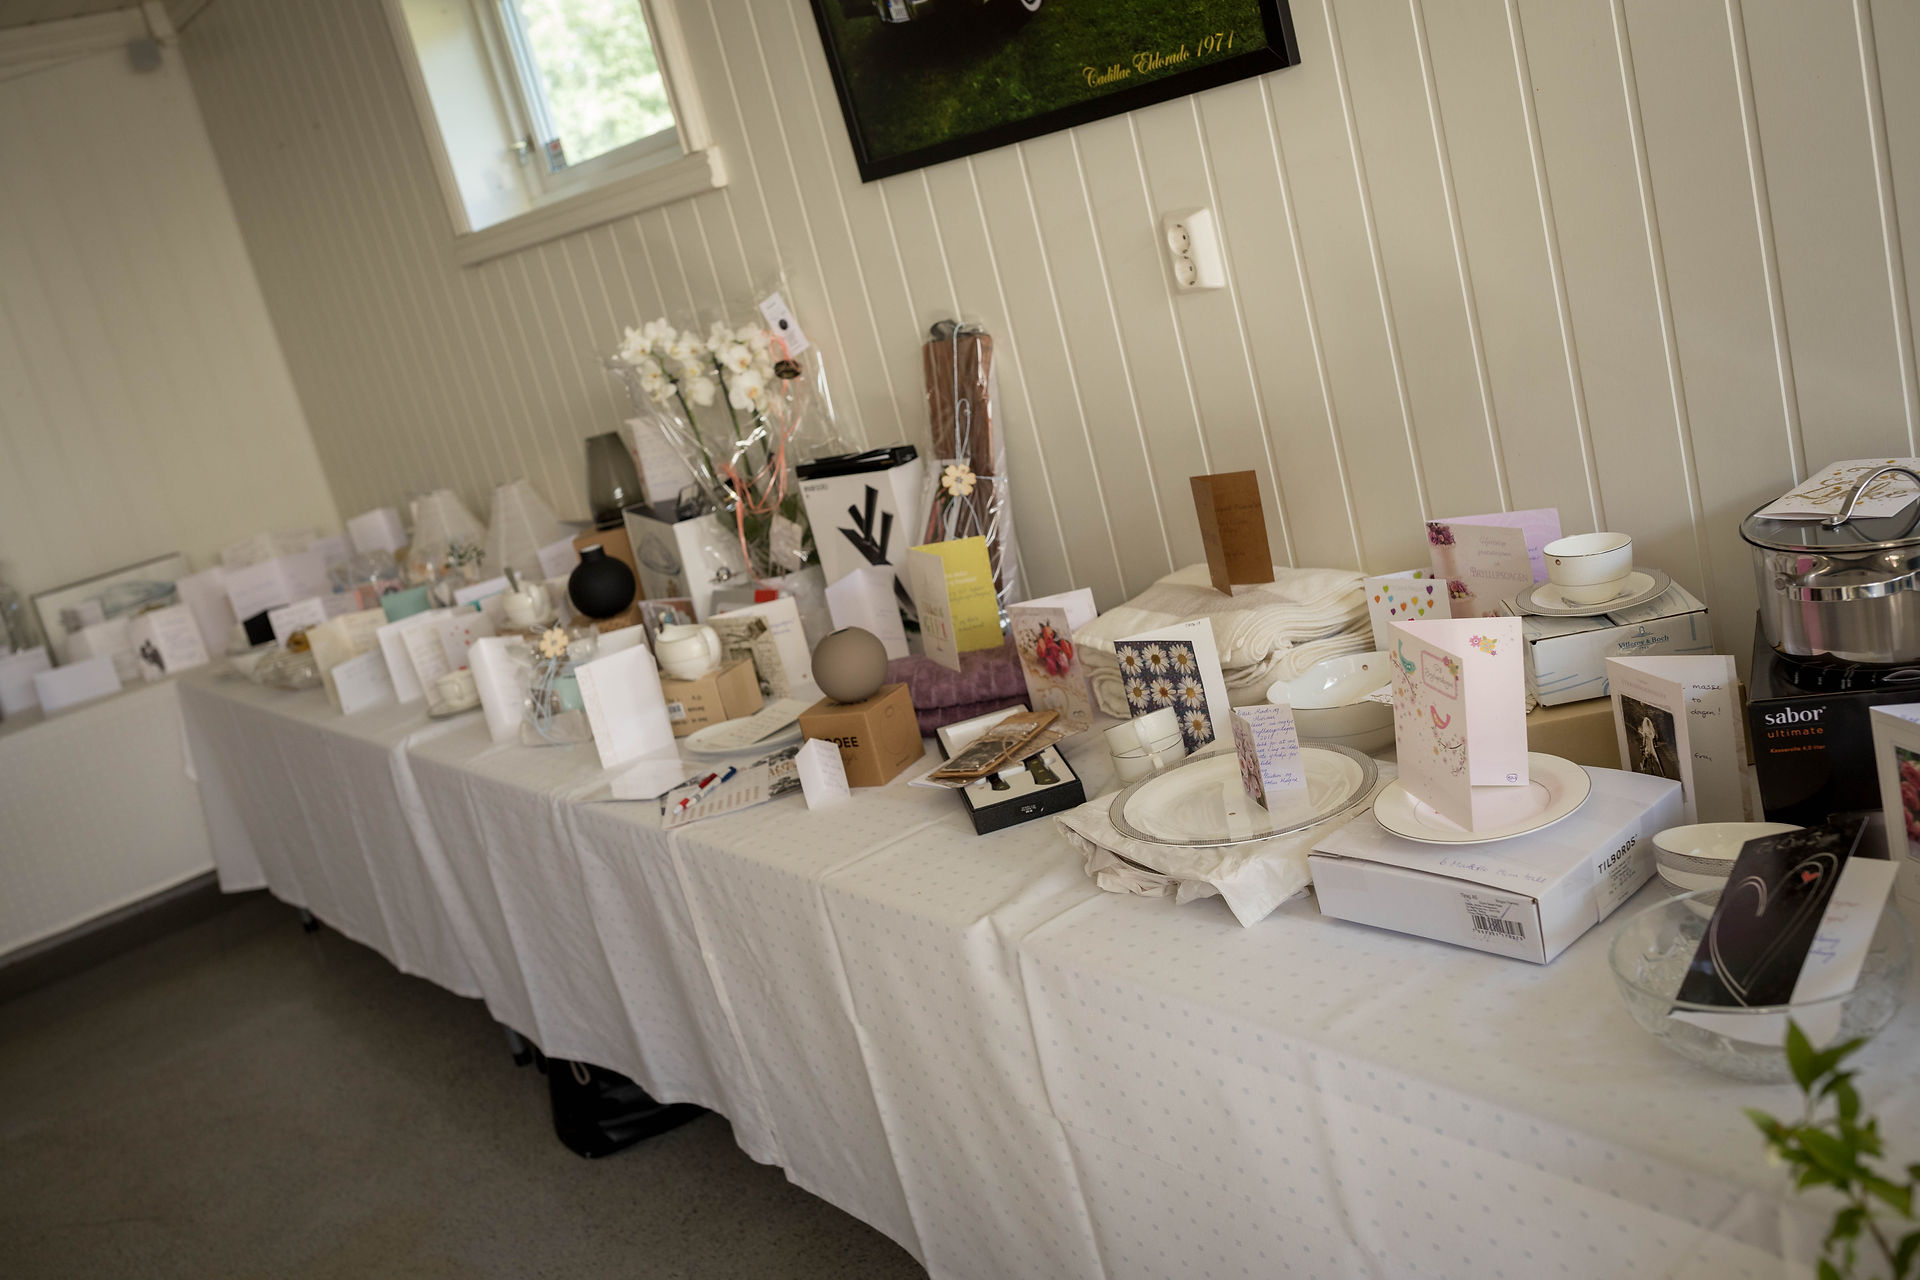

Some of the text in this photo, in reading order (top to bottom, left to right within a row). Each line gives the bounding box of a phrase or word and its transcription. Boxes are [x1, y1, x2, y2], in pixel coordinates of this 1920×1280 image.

[1082, 30, 1235, 88] Cadillac Eldorado 1971
[1651, 635, 1670, 643] Boch
[1767, 727, 1824, 739] ultimate
[1598, 836, 1636, 874] TILBORDS
